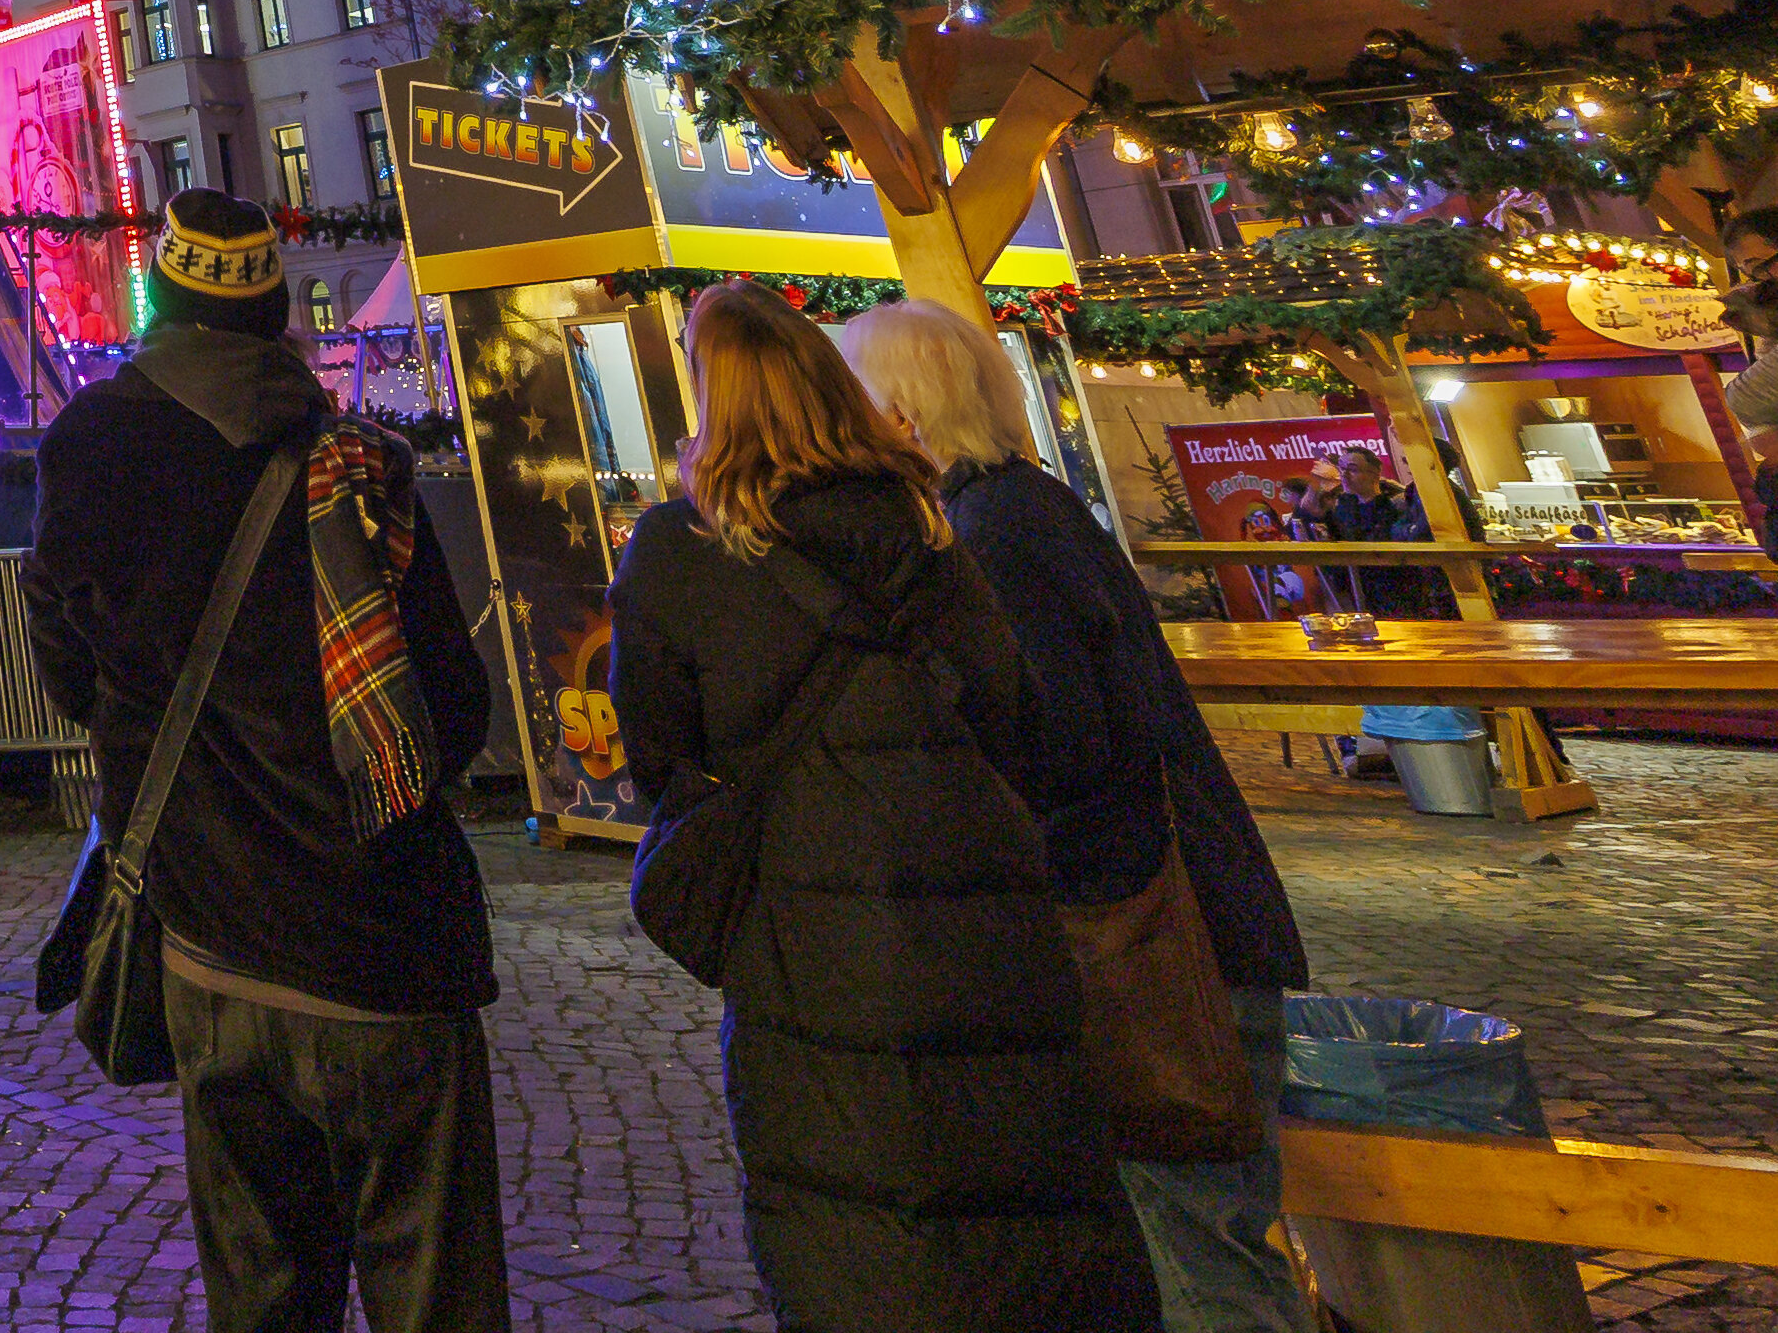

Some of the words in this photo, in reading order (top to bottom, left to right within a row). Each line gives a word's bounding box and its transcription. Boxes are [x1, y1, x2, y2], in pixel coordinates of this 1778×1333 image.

[415, 106, 595, 174] TICKETS
[1183, 436, 1268, 465] Herzlich
[554, 686, 619, 754] SP
